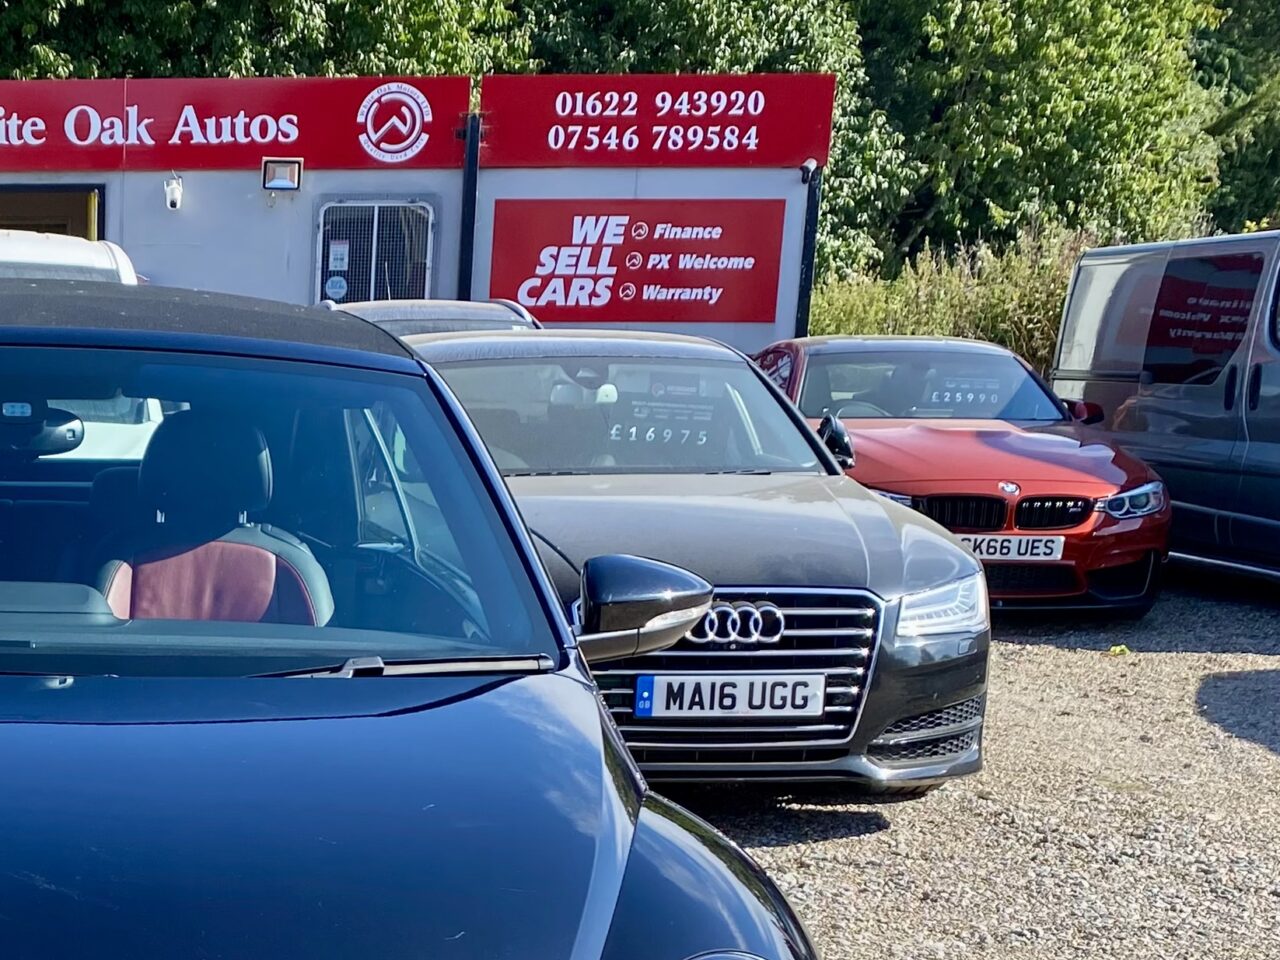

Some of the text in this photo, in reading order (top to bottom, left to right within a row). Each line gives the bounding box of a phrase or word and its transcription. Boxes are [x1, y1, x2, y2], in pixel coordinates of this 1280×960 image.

[555, 90, 766, 117] 01622 943920
[64, 104, 156, 146] Oak
[168, 104, 300, 144] Autos
[547, 125, 760, 150] 07546 789584
[571, 215, 630, 245] WE
[653, 223, 722, 239] Finance
[535, 246, 618, 276] SELL
[646, 253, 756, 270] PX Welcome
[517, 276, 615, 307] CARS
[642, 284, 724, 305] Warranty
[1017, 538, 1056, 557] UES
[638, 700, 651, 709] GB
[664, 680, 810, 711] MA16 UGG
